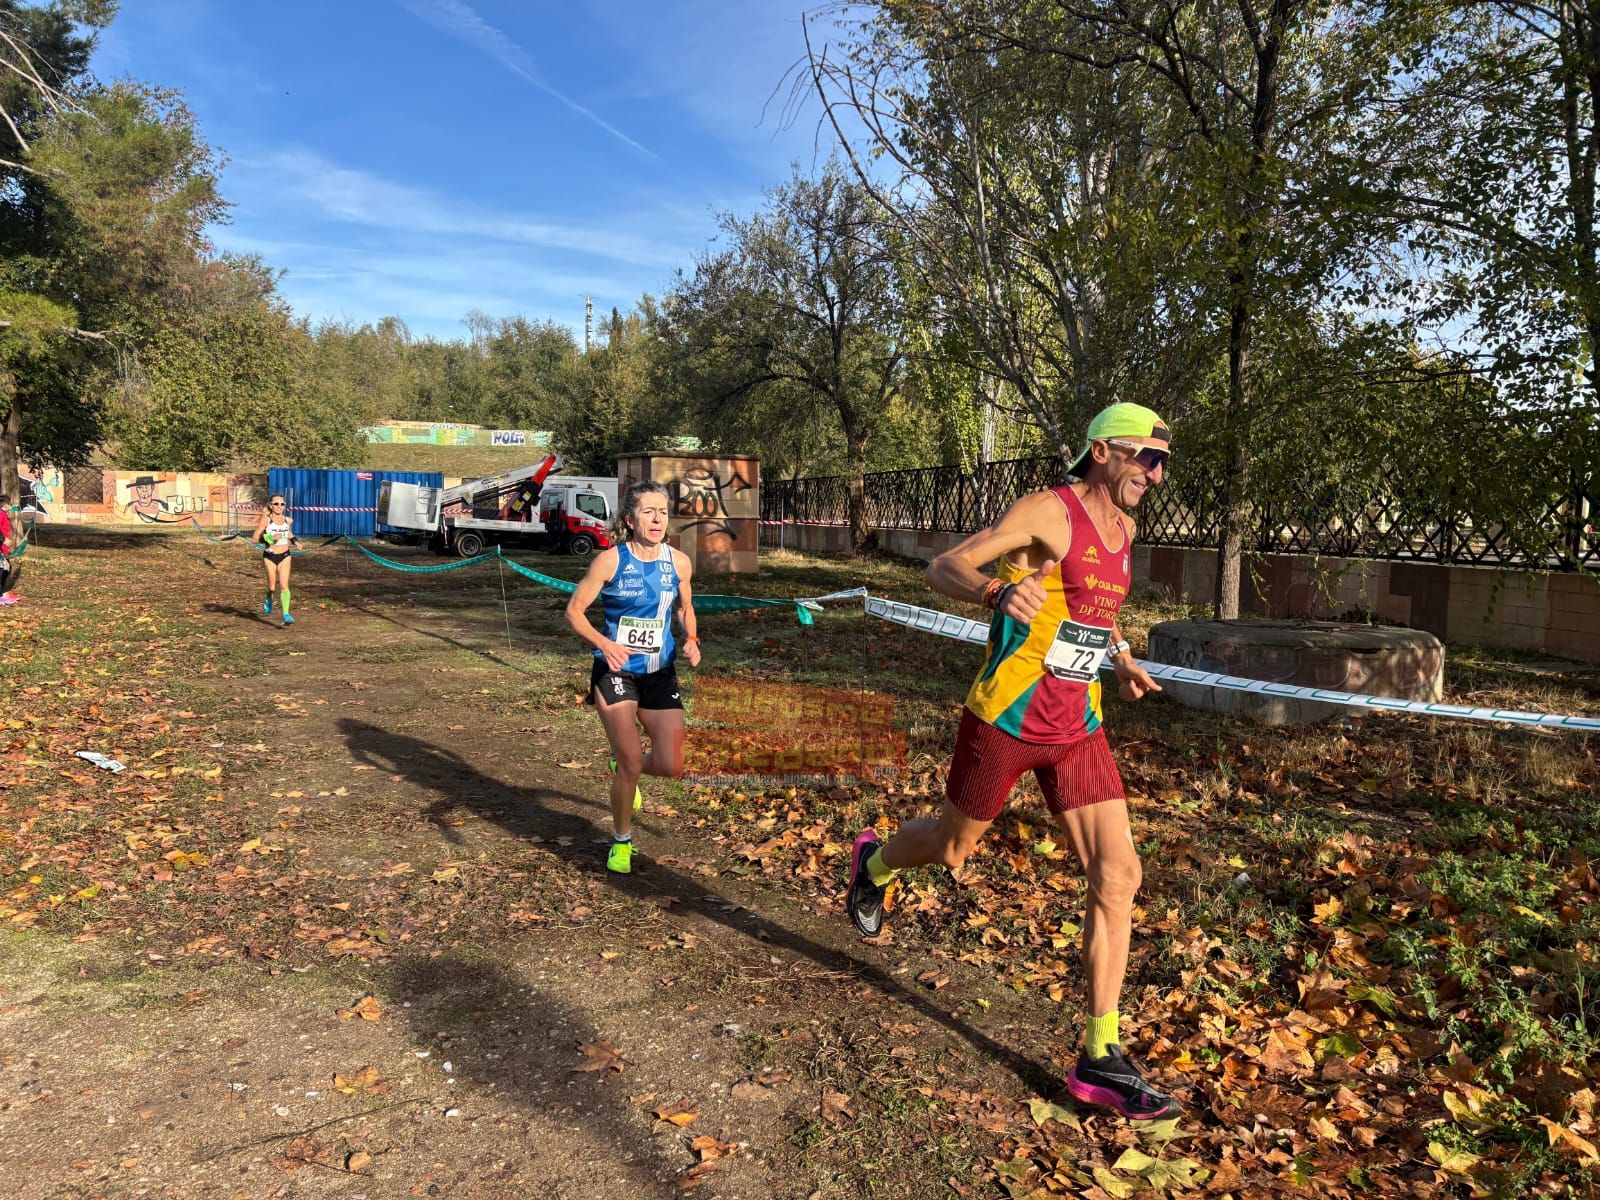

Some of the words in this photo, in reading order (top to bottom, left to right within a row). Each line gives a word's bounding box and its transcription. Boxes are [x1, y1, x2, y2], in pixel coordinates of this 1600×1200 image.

[1094, 595, 1117, 609] VINO
[628, 629, 655, 646] 645
[1070, 649, 1096, 671] 72
